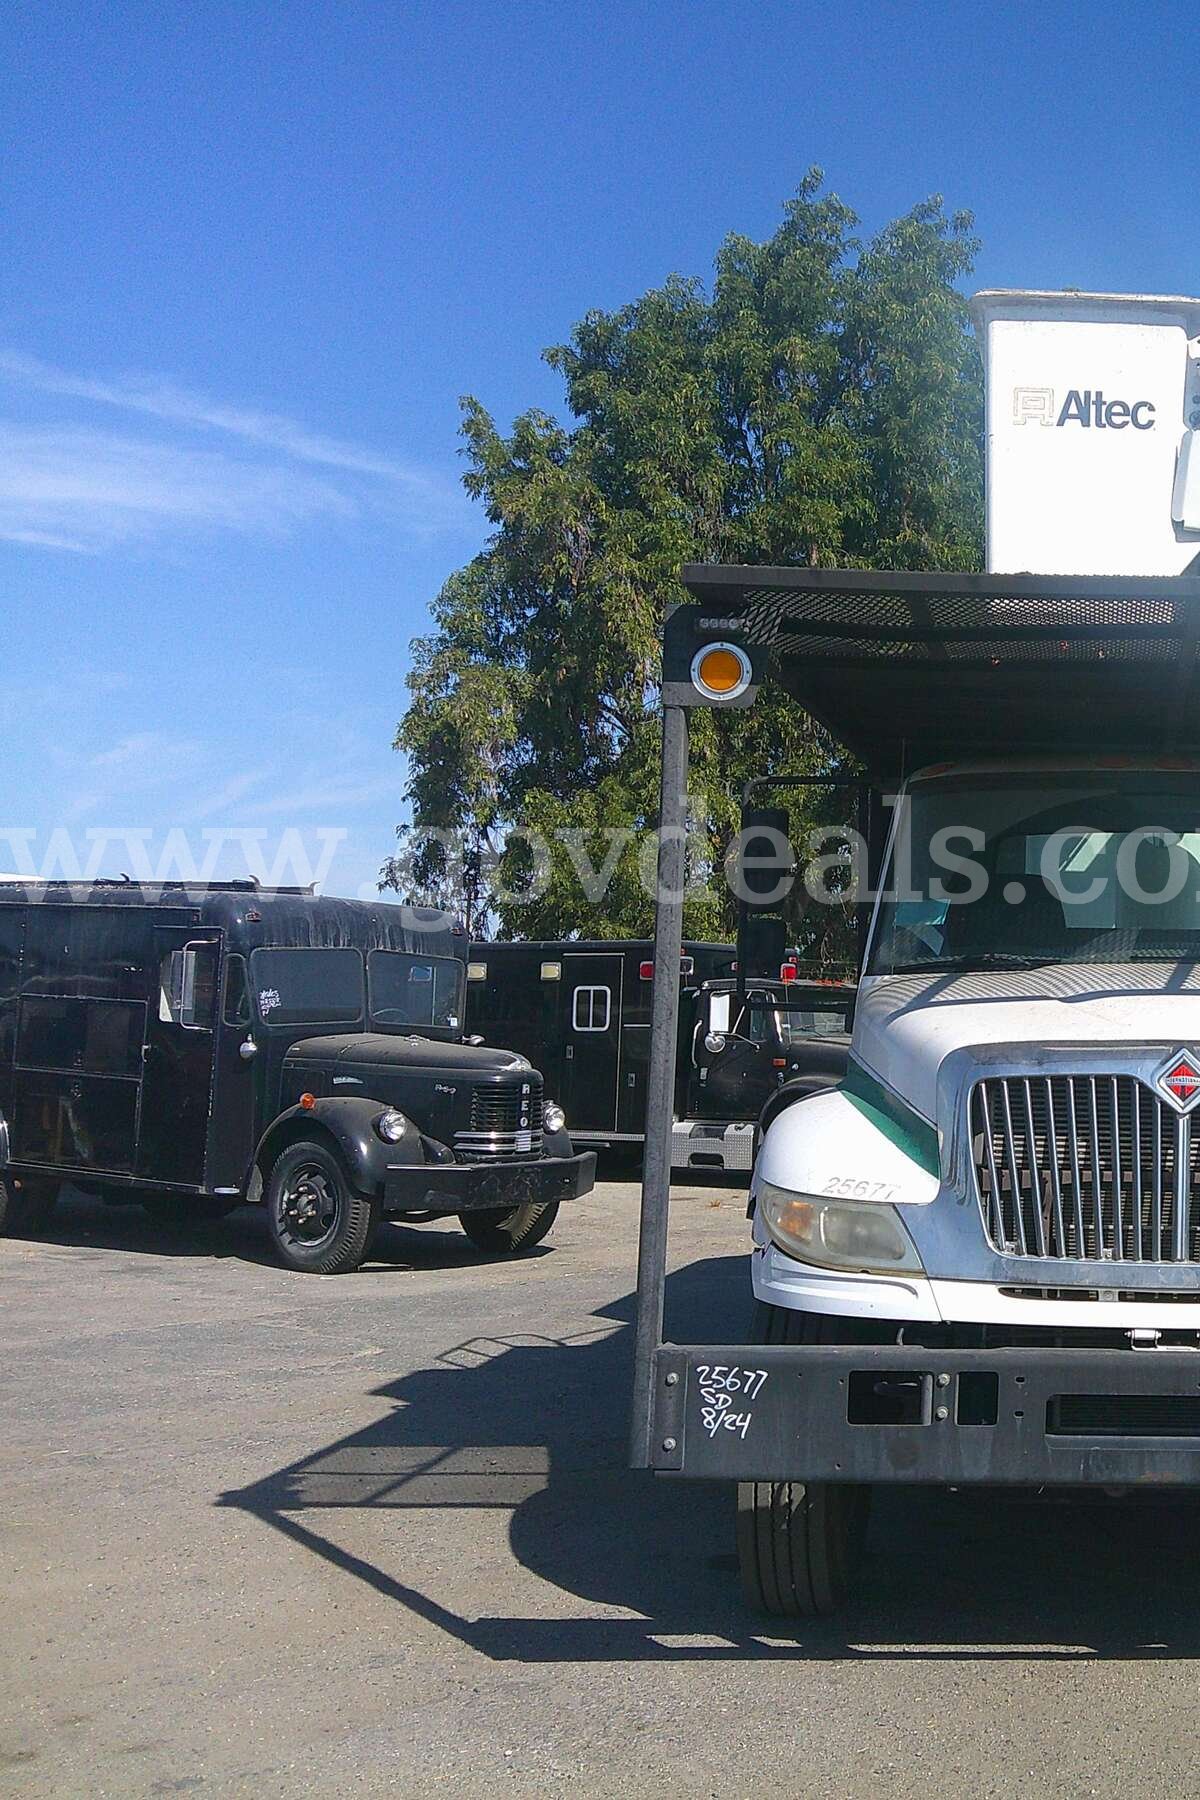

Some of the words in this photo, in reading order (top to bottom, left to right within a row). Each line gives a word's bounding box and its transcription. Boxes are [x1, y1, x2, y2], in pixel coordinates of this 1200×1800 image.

[1056, 389, 1157, 431] Altec
[519, 1083, 532, 1128] REO
[821, 1176, 902, 1200] 25677
[696, 1365, 769, 1400] 25677
[701, 1407, 752, 1439] 8/24
